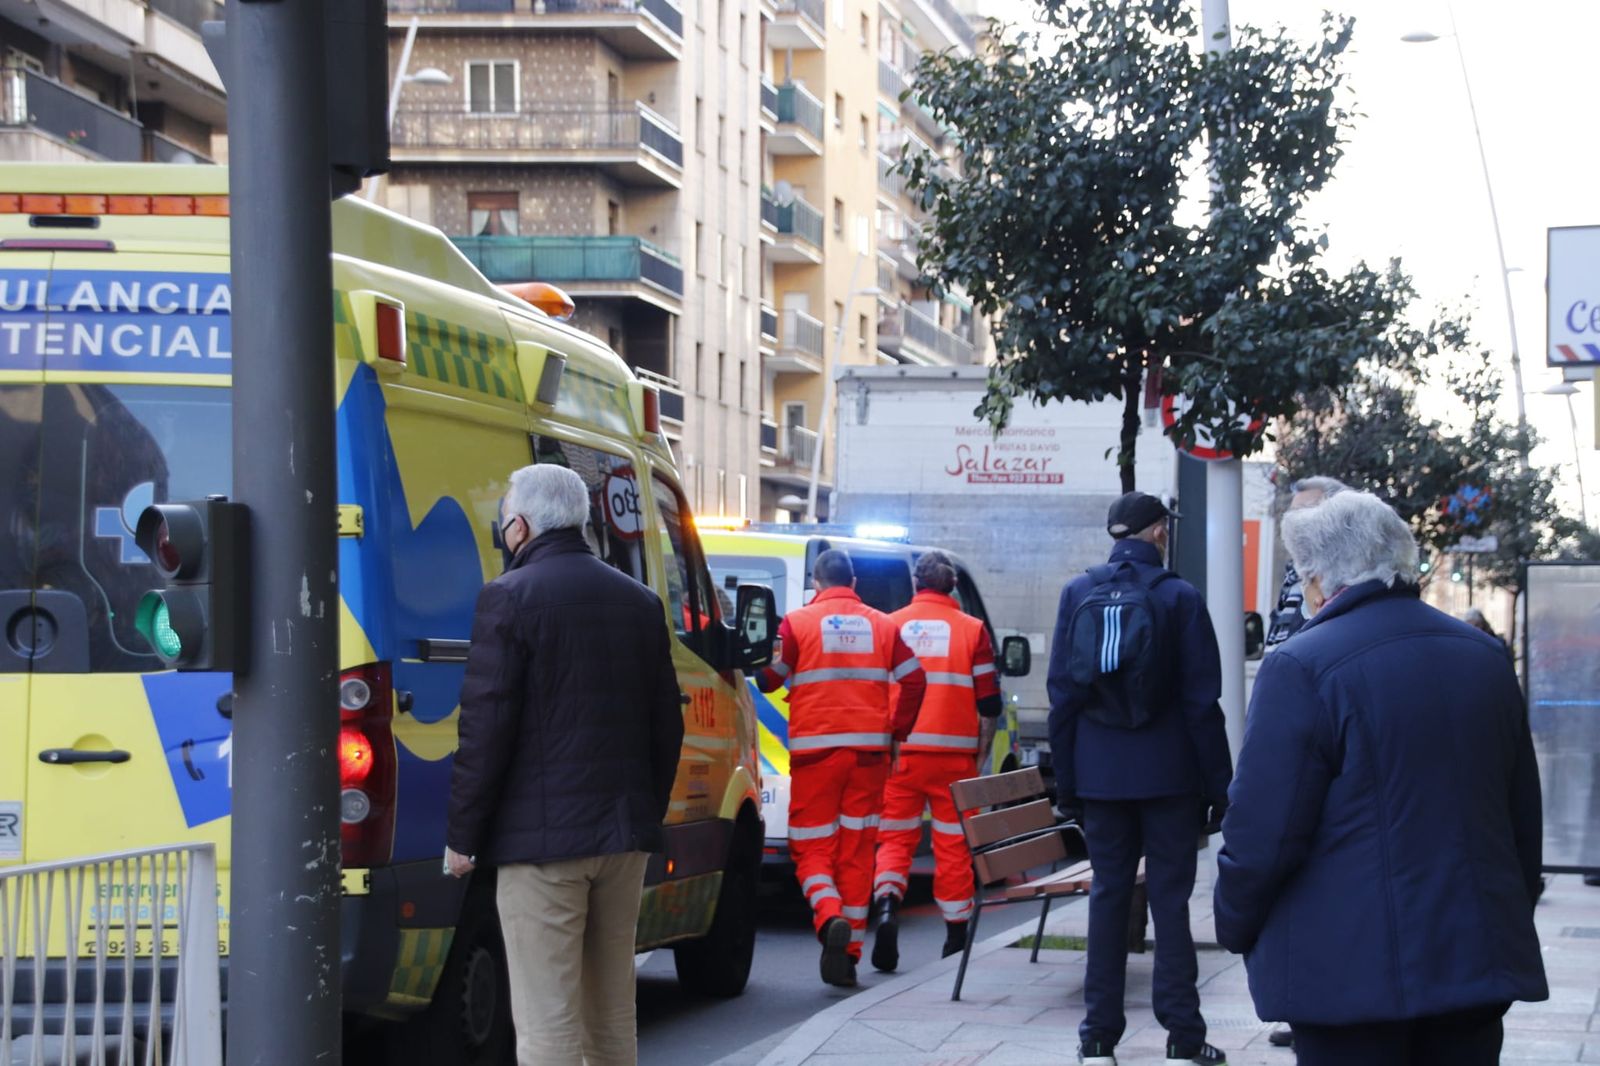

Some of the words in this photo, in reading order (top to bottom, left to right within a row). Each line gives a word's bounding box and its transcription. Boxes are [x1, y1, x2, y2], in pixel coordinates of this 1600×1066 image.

[0, 279, 231, 315] ULANCIA
[1, 322, 232, 358] TENCIAL
[945, 444, 1052, 476] Salazar
